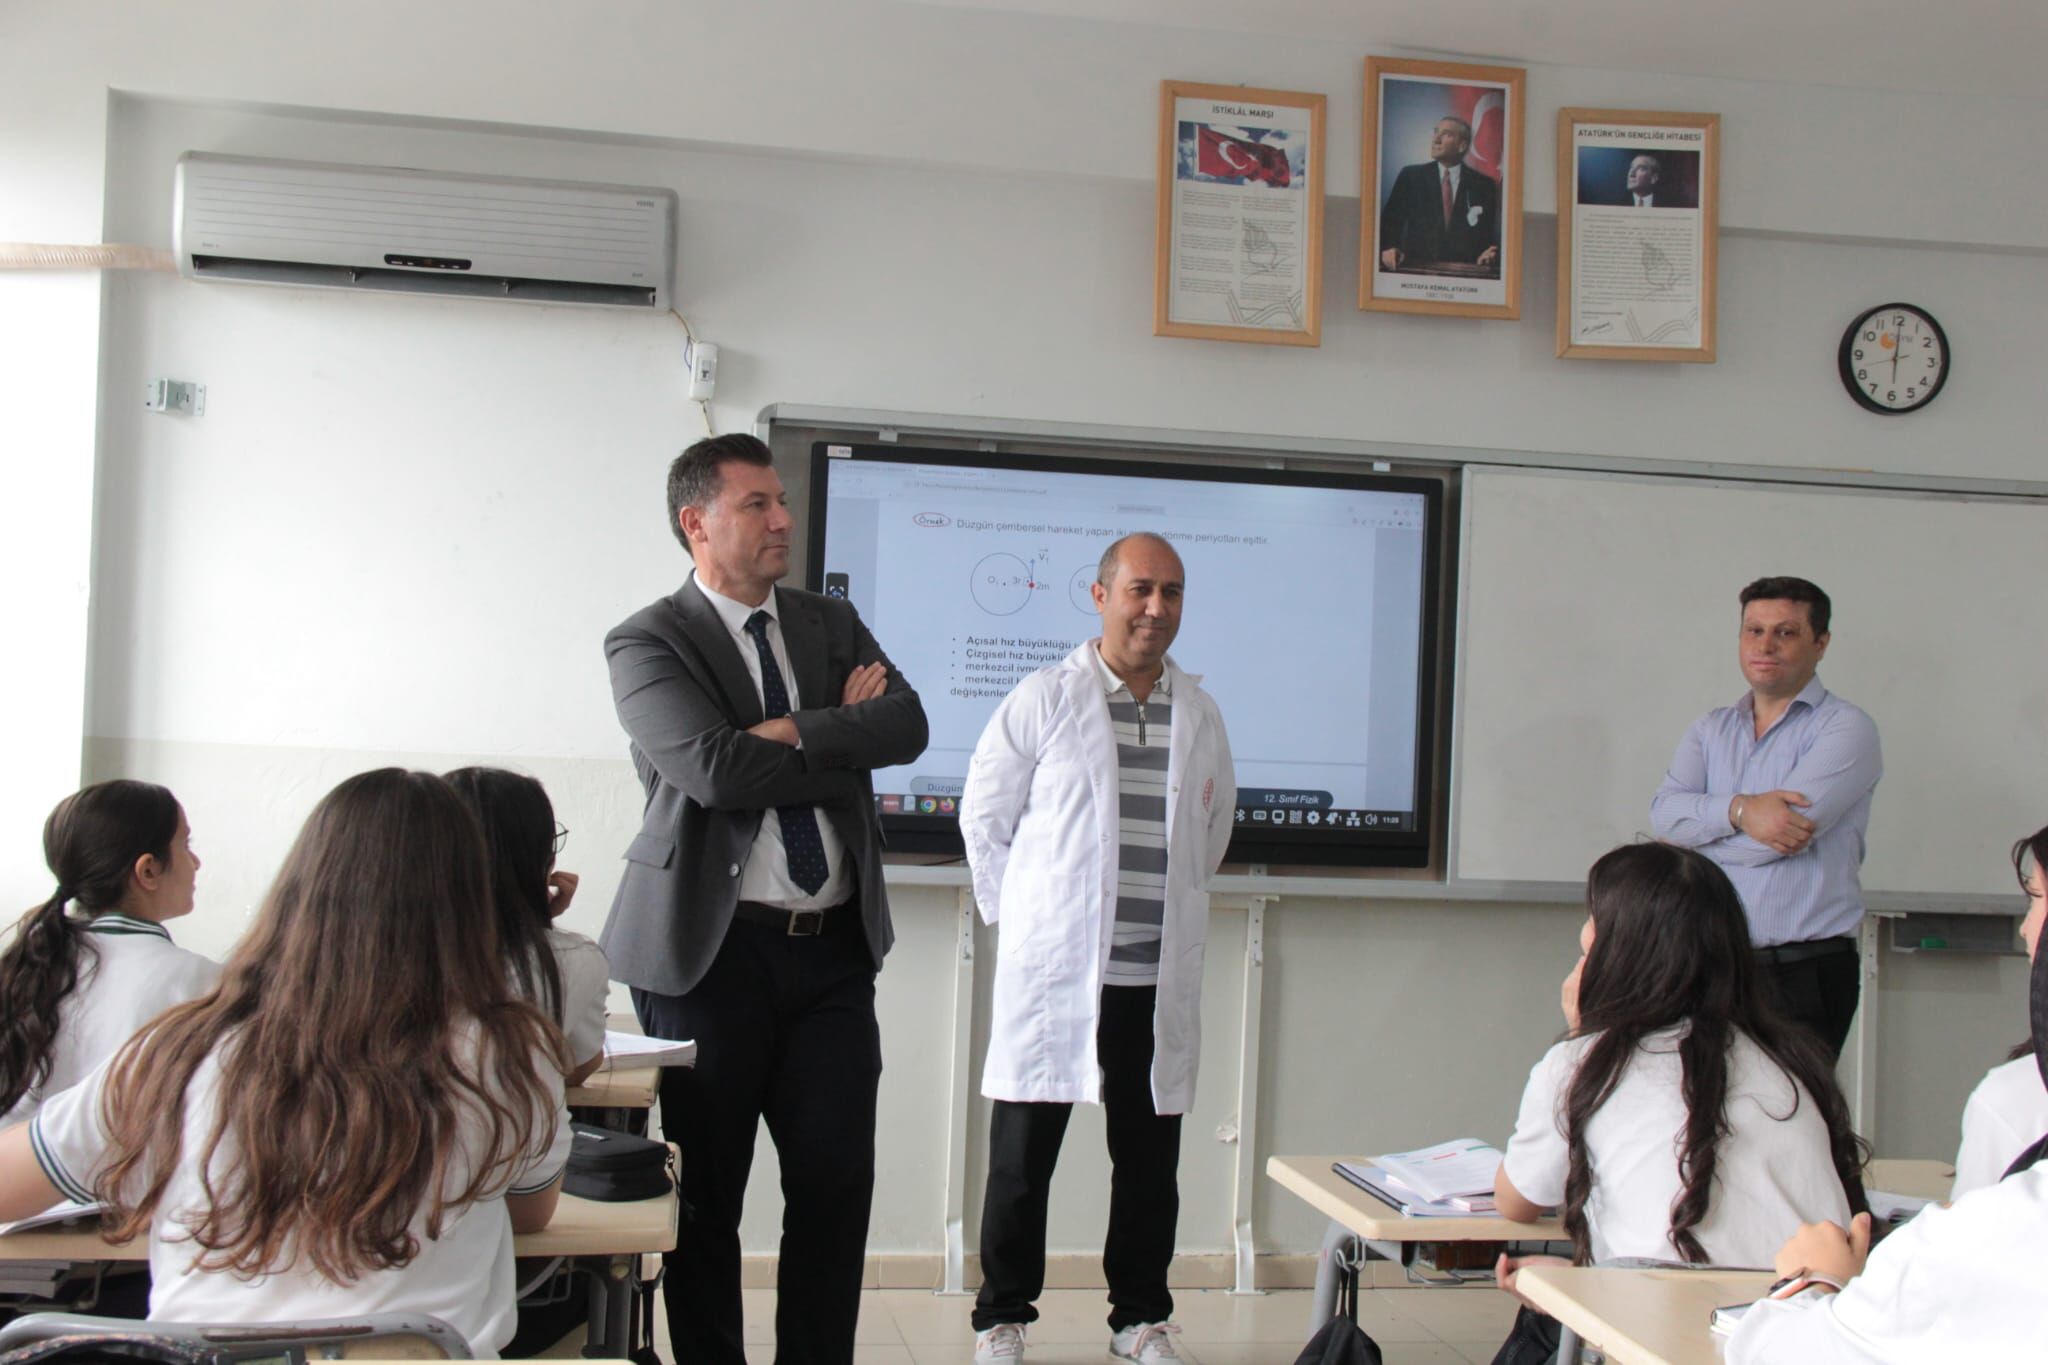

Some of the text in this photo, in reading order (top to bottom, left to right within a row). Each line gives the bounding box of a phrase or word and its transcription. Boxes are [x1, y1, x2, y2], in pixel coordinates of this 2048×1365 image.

[1249, 110, 1274, 119] MARŞI
[1876, 319, 1884, 330] 11
[1893, 315, 1904, 326] 12
[1915, 323, 1919, 334] 1
[1864, 330, 1875, 341] 10
[1923, 337, 1931, 348] 2
[1854, 349, 1863, 360] 9
[1927, 357, 1935, 368] 3
[1858, 369, 1867, 380] 8
[1920, 376, 1927, 386] 4
[1869, 383, 1877, 394] 7
[1906, 387, 1915, 398] 5
[1887, 390, 1896, 401] 6
[918, 513, 944, 525] Örnek
[956, 519, 993, 531] Düzgün
[996, 523, 1045, 533] çembersel
[1048, 525, 1083, 535] hareket
[1085, 527, 1114, 537] yapan
[966, 636, 998, 647] Açısal
[1000, 637, 1016, 646] hız
[1018, 638, 1071, 650] büyüklüğü
[966, 648, 1067, 663] Çizgisel hız büyüklü
[965, 663, 1014, 672] merkezcil
[965, 676, 1014, 685] merkezcil
[1264, 794, 1276, 804] 12.
[1278, 794, 1299, 804] Sınıf
